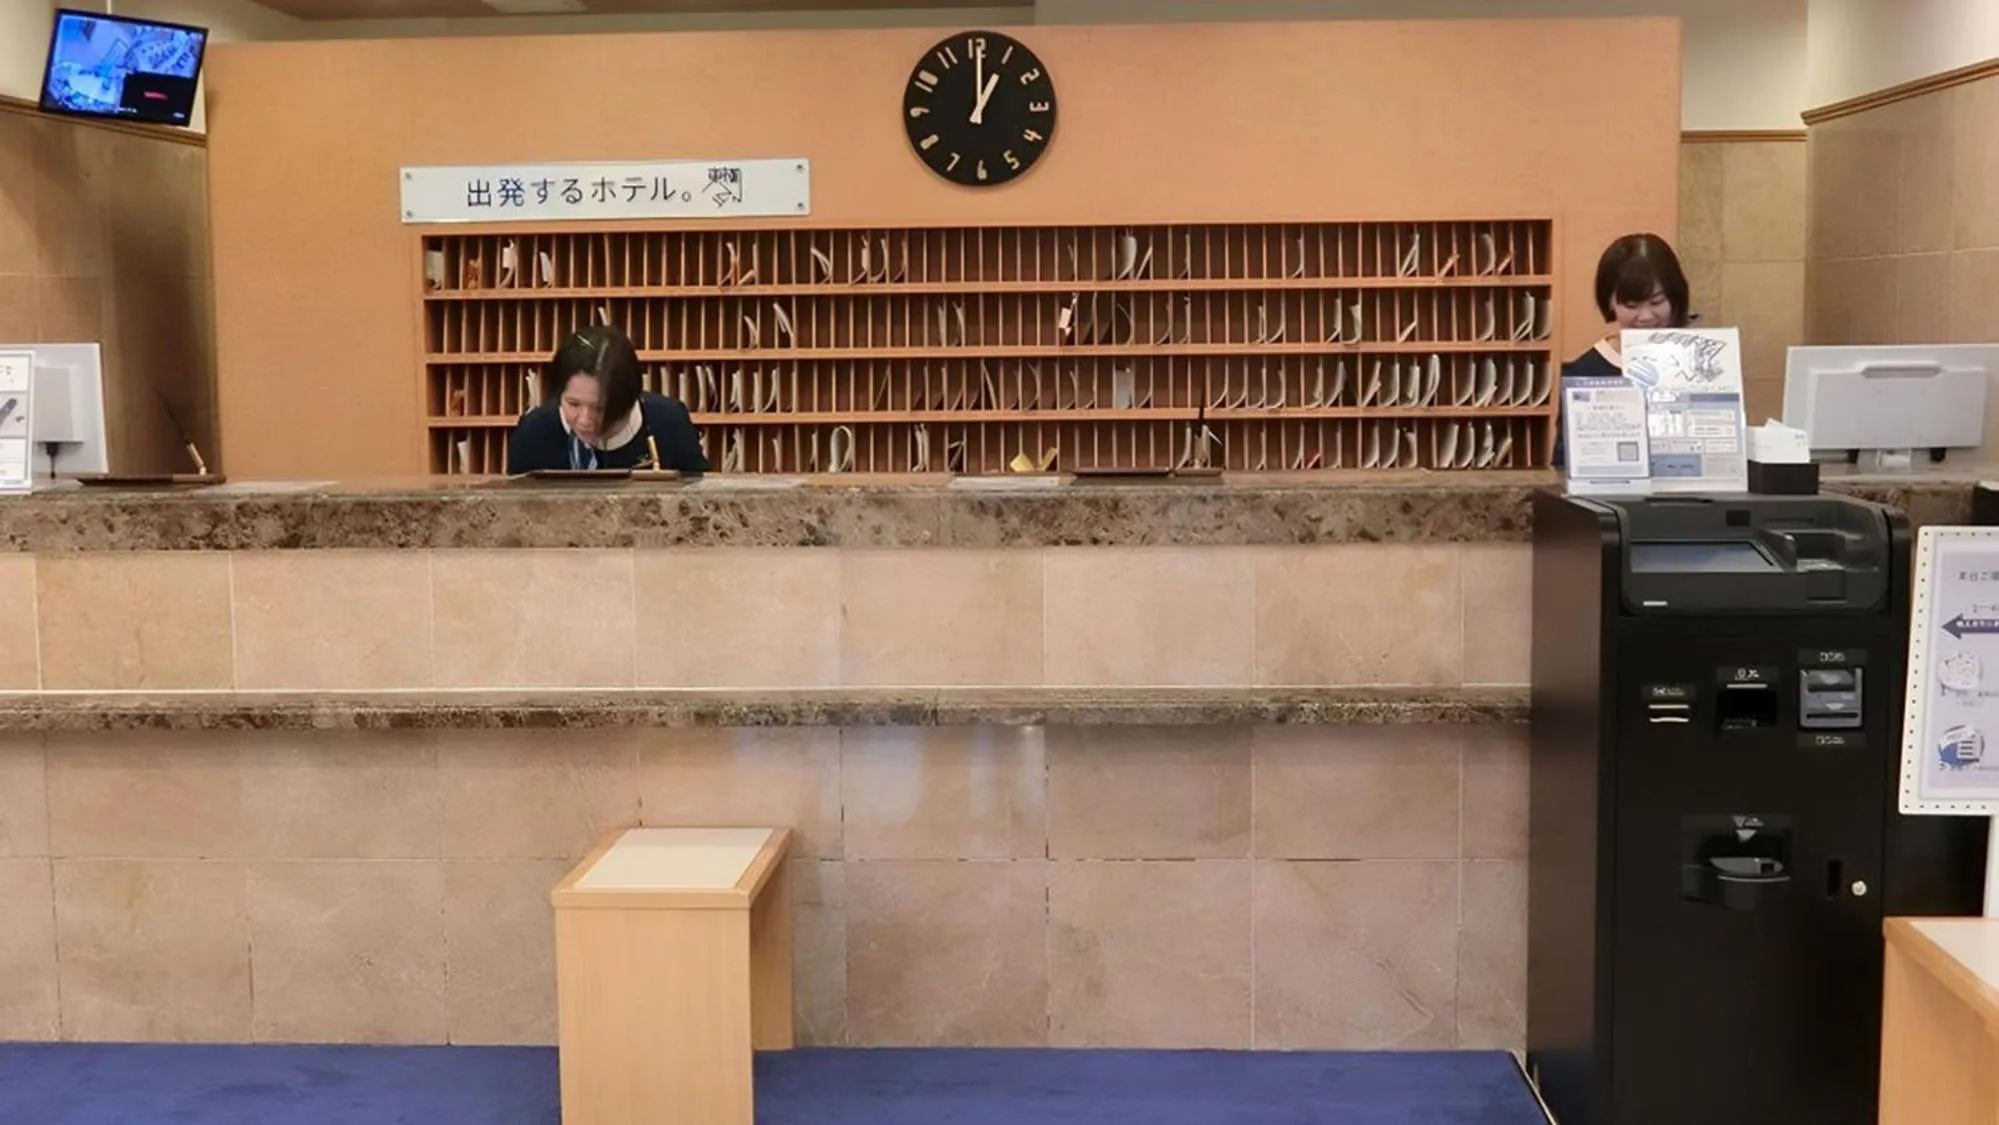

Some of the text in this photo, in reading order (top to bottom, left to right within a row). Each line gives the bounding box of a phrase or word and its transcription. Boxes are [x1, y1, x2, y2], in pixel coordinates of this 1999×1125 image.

[936, 46, 958, 70] 11
[968, 38, 987, 59] 12
[1001, 45, 1013, 65] 1
[914, 69, 938, 93] 10
[1020, 67, 1040, 85] 2
[909, 106, 930, 118] 9
[1029, 101, 1049, 112] 3
[1023, 128, 1043, 142] 4
[946, 152, 960, 172] 7
[1003, 149, 1020, 170] 5
[976, 159, 988, 181] 6
[467, 176, 692, 207] 出発するホテル。
